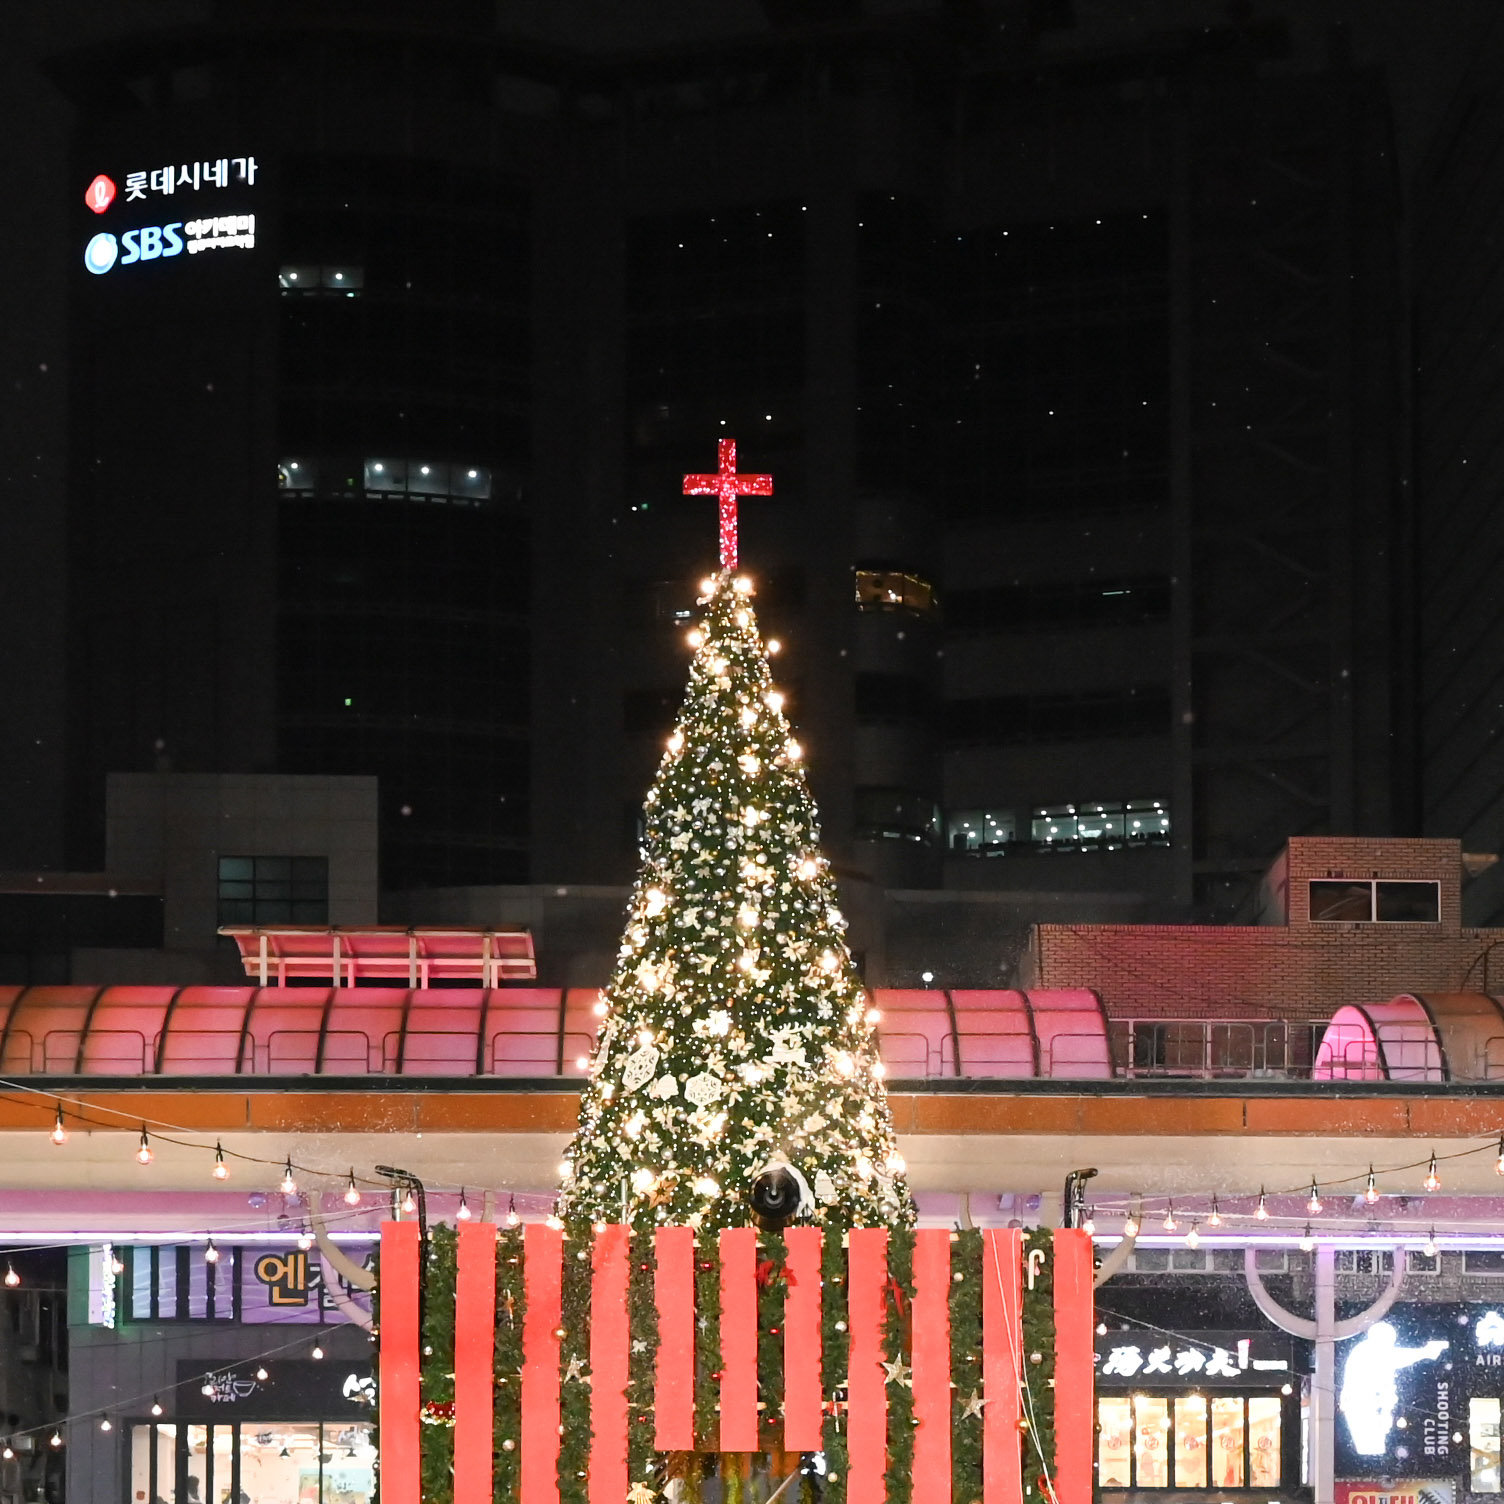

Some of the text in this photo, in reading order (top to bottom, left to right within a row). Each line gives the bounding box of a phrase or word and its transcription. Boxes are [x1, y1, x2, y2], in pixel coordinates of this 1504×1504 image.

[121, 222, 184, 265] SBS
[1424, 1418, 1436, 1455] CLUB
[1437, 1382, 1449, 1455] SHOOTING
